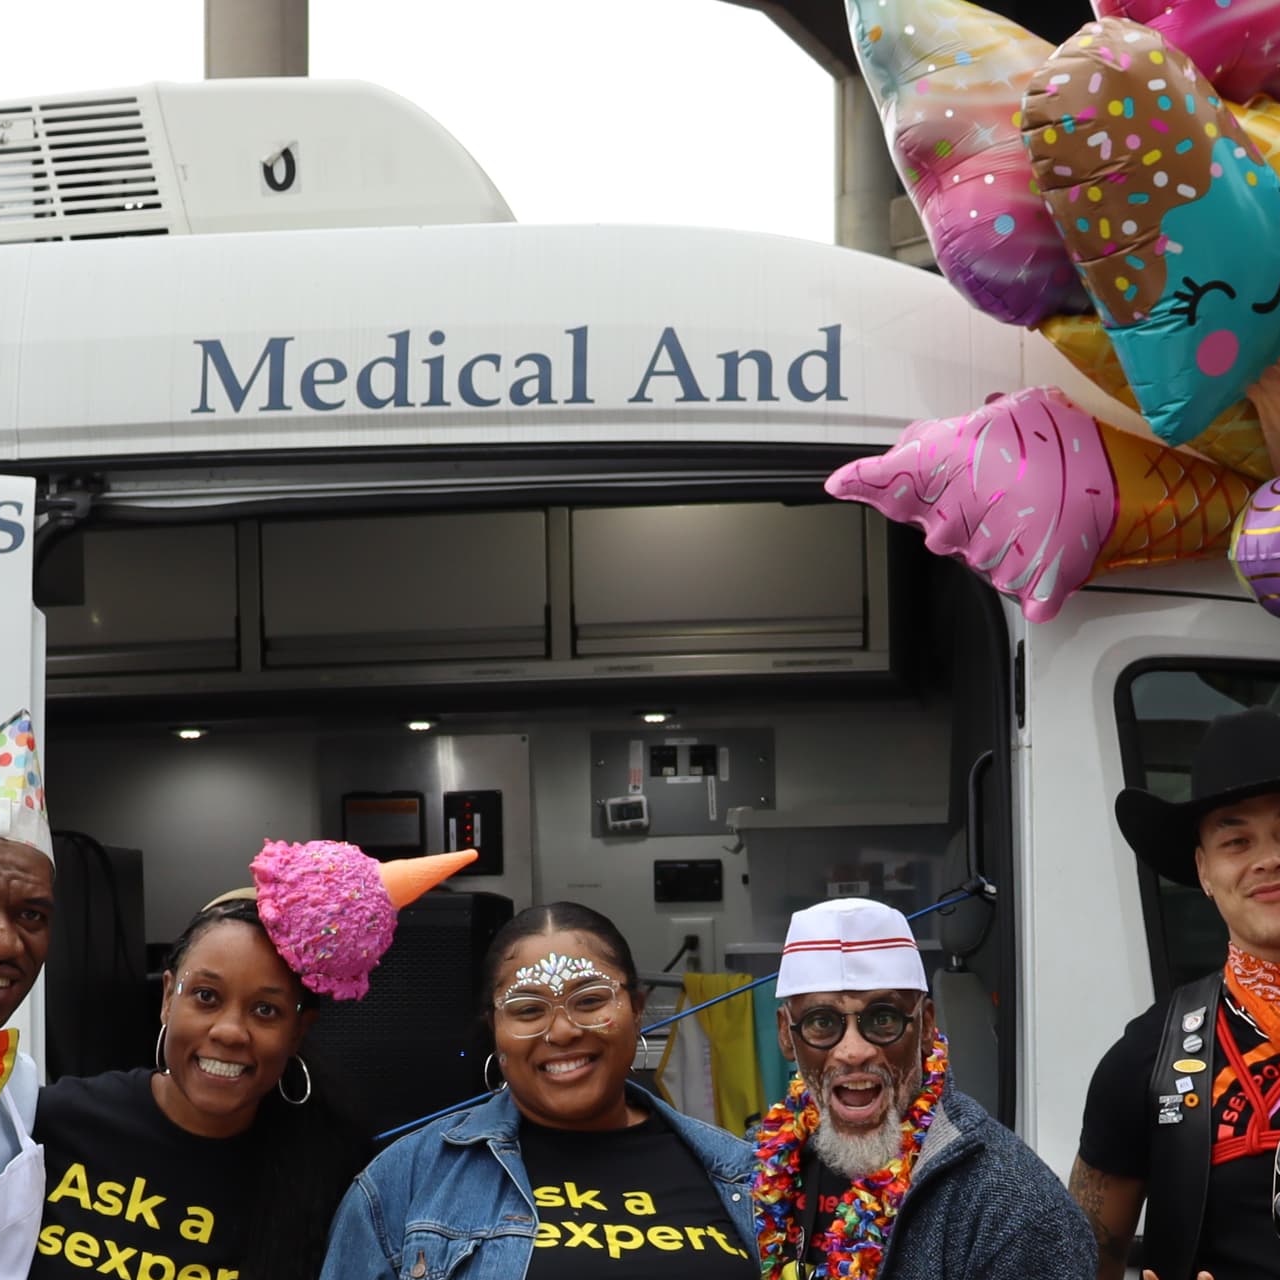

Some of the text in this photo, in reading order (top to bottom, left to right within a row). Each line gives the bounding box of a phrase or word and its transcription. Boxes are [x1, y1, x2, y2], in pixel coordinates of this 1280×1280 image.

[191, 324, 849, 414] Medical And
[1222, 1090, 1250, 1123] SE
[47, 1163, 215, 1244] Ask a
[533, 1182, 656, 1216] sk a
[534, 1221, 749, 1260] expert.
